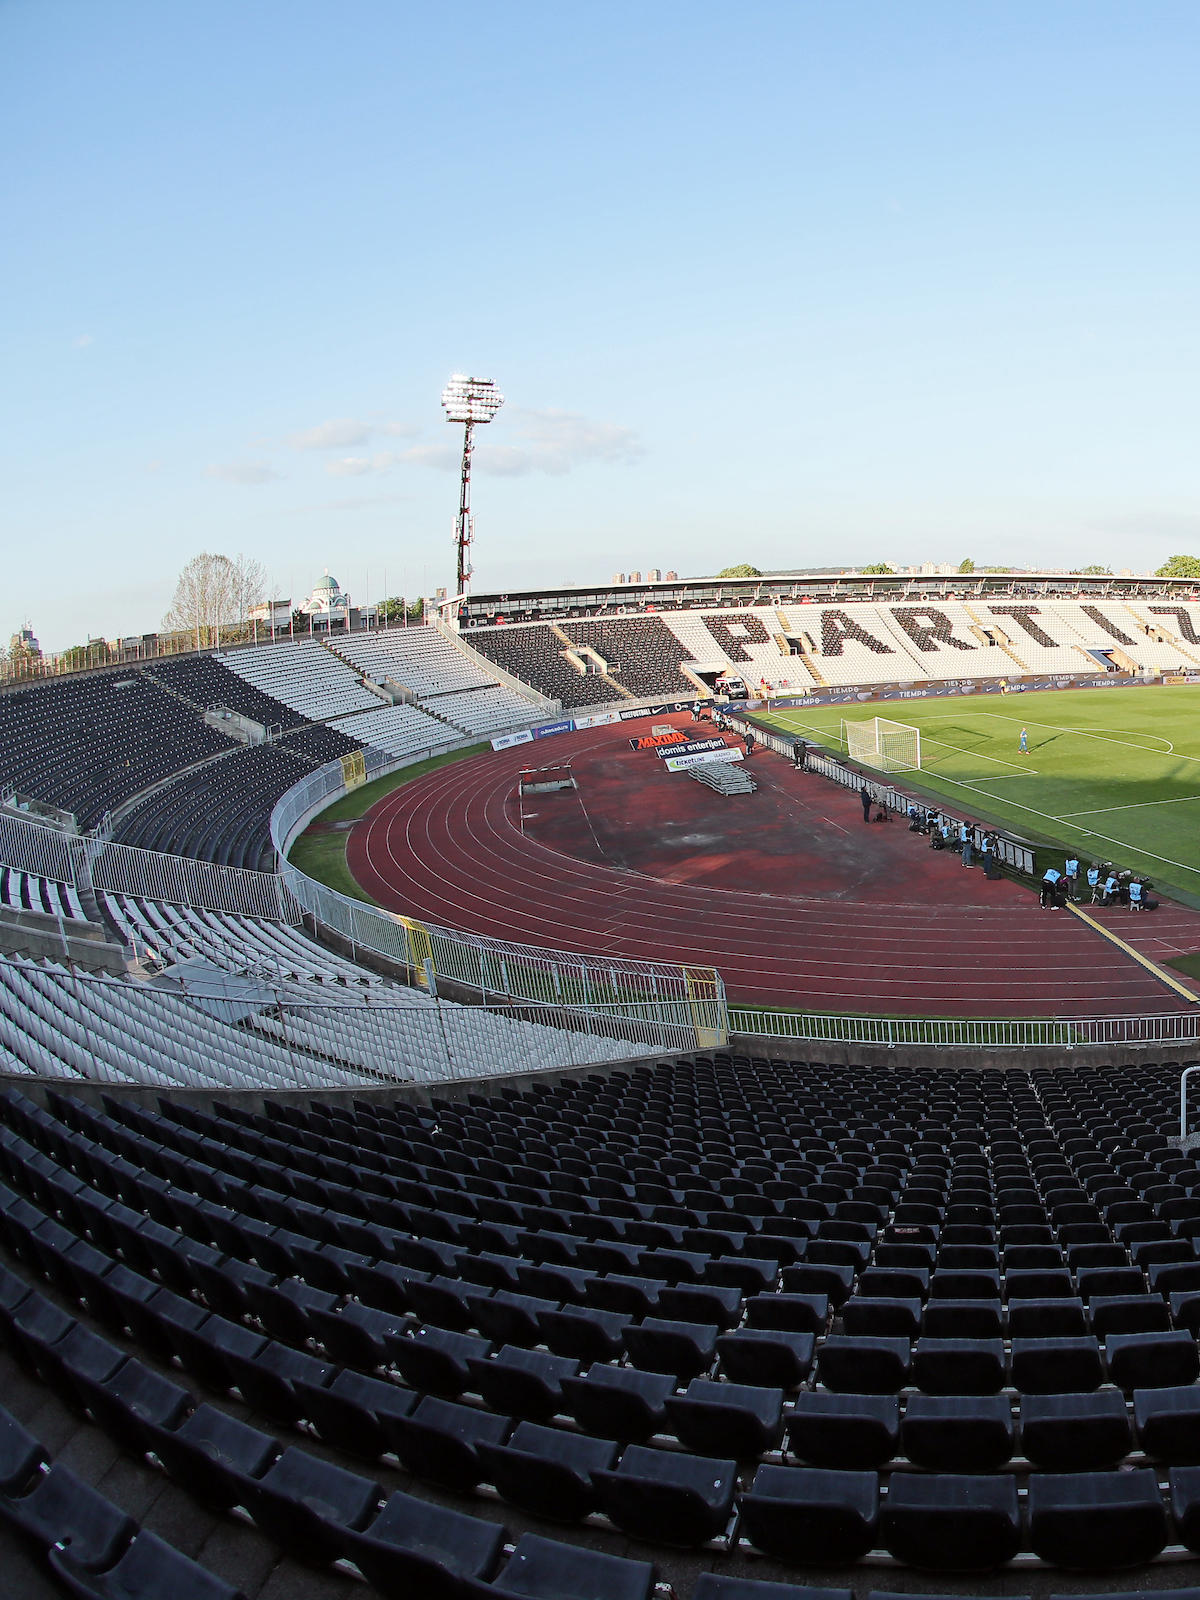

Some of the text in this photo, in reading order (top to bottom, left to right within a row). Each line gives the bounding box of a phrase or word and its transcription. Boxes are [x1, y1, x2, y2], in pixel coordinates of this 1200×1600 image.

[828, 687, 863, 695] TIEMPO
[899, 690, 930, 698] TIEMPO
[790, 698, 823, 706] TIEMPO
[637, 731, 690, 749] MAXIMA
[659, 738, 725, 756] domis enterijeri
